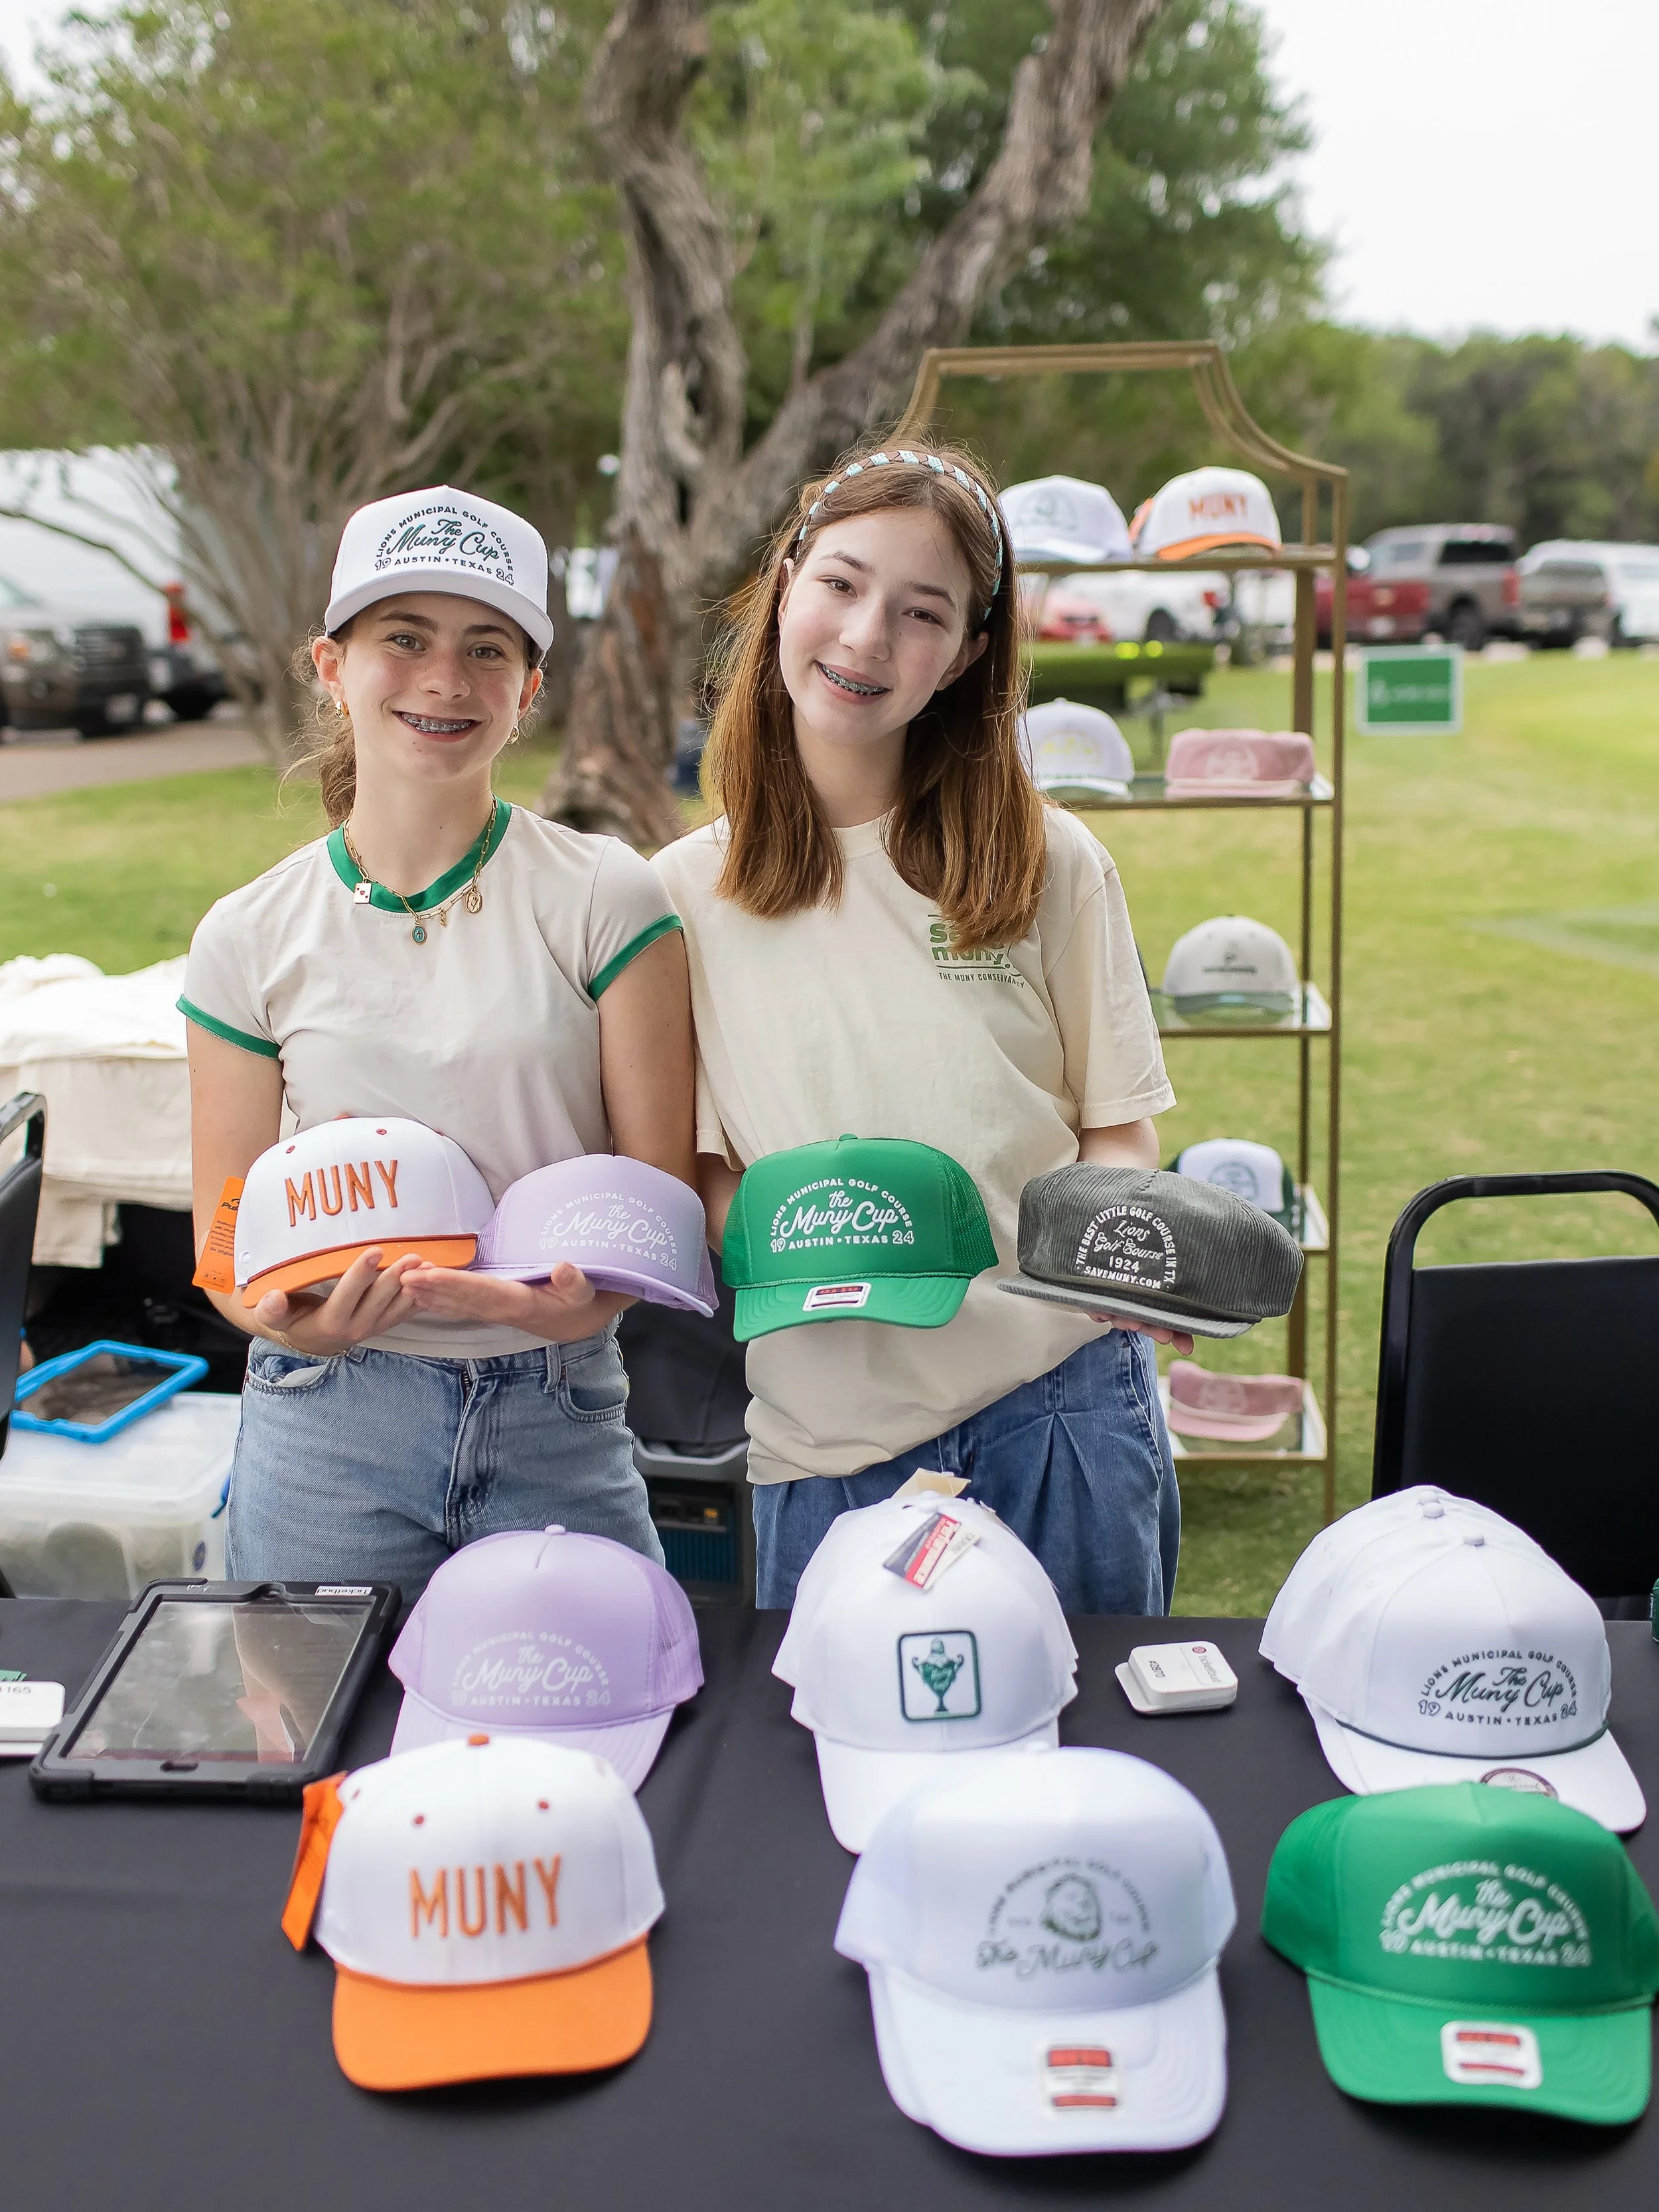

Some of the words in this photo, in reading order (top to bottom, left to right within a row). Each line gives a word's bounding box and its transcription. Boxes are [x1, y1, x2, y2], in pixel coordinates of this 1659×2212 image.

[376, 528, 396, 557] LIONS
[399, 506, 457, 528] MUNICIPAL
[463, 511, 488, 529] GOLF
[490, 531, 514, 571] COURSE
[431, 519, 462, 536] The
[386, 524, 457, 555] Muny
[459, 533, 500, 561] Cup
[375, 557, 392, 571] 19
[395, 555, 441, 565] AUSTIN
[453, 558, 492, 575] TEXAS
[496, 568, 514, 586] 24
[955, 973, 974, 982] MUNY
[285, 1159, 397, 1227] MUNY
[829, 1190, 853, 1208] the
[609, 1204, 630, 1219] the
[770, 1205, 786, 1236] LIONS
[786, 1178, 843, 1205] MUNICIPAL
[848, 1179, 878, 1191] GOLF
[881, 1190, 912, 1228] COURSE
[779, 1205, 853, 1238] Muny
[851, 1201, 899, 1233] Cup
[1096, 1206, 1127, 1224] LITTLE
[1129, 1207, 1153, 1222] GOLF
[541, 1209, 563, 1236] LIONS
[565, 1192, 624, 1209] MUNICIPAL
[628, 1197, 654, 1213] GOLF
[656, 1215, 677, 1255] COURSE
[553, 1211, 629, 1239] Muny
[628, 1219, 668, 1249] Cup
[1114, 1220, 1150, 1241] Lions
[1152, 1217, 1177, 1254] COURSE
[539, 1237, 557, 1250] 19
[620, 1244, 657, 1260] TEXAS
[660, 1253, 677, 1271] 24
[770, 1238, 786, 1252] 19
[788, 1236, 833, 1250] AUSTIN
[845, 1235, 889, 1244] TEXAS
[892, 1230, 914, 1244] 24
[1094, 1231, 1124, 1252] Golf
[1122, 1238, 1163, 1260] Course
[1076, 1247, 1088, 1265] THE
[1109, 1256, 1140, 1273] 1924
[1166, 1257, 1177, 1268] IN
[1084, 1266, 1161, 1290] SAVEMUNY.COM
[1163, 1270, 1176, 1284] TX
[518, 1644, 545, 1664] the
[462, 1659, 543, 1694] Muny
[541, 1657, 594, 1693] Cup
[1421, 1664, 1449, 1696] LIONS
[1451, 1649, 1523, 1668] MUNICIPAL
[1528, 1651, 1554, 1663] GOLF
[1492, 1666, 1528, 1686] The
[470, 1695, 521, 1706] AUSTIN
[533, 1695, 582, 1706] TEXAS
[1435, 1670, 1520, 1712] Muny
[1524, 1670, 1563, 1707] Cup
[1418, 1699, 1441, 1716] 19
[1445, 1711, 1502, 1725] AUSTIN
[1515, 1713, 1557, 1726] TEXAS
[408, 1852, 562, 1940] MUNY
[1398, 1891, 1510, 1944] Muny
[1507, 1898, 1572, 1948] Cup
